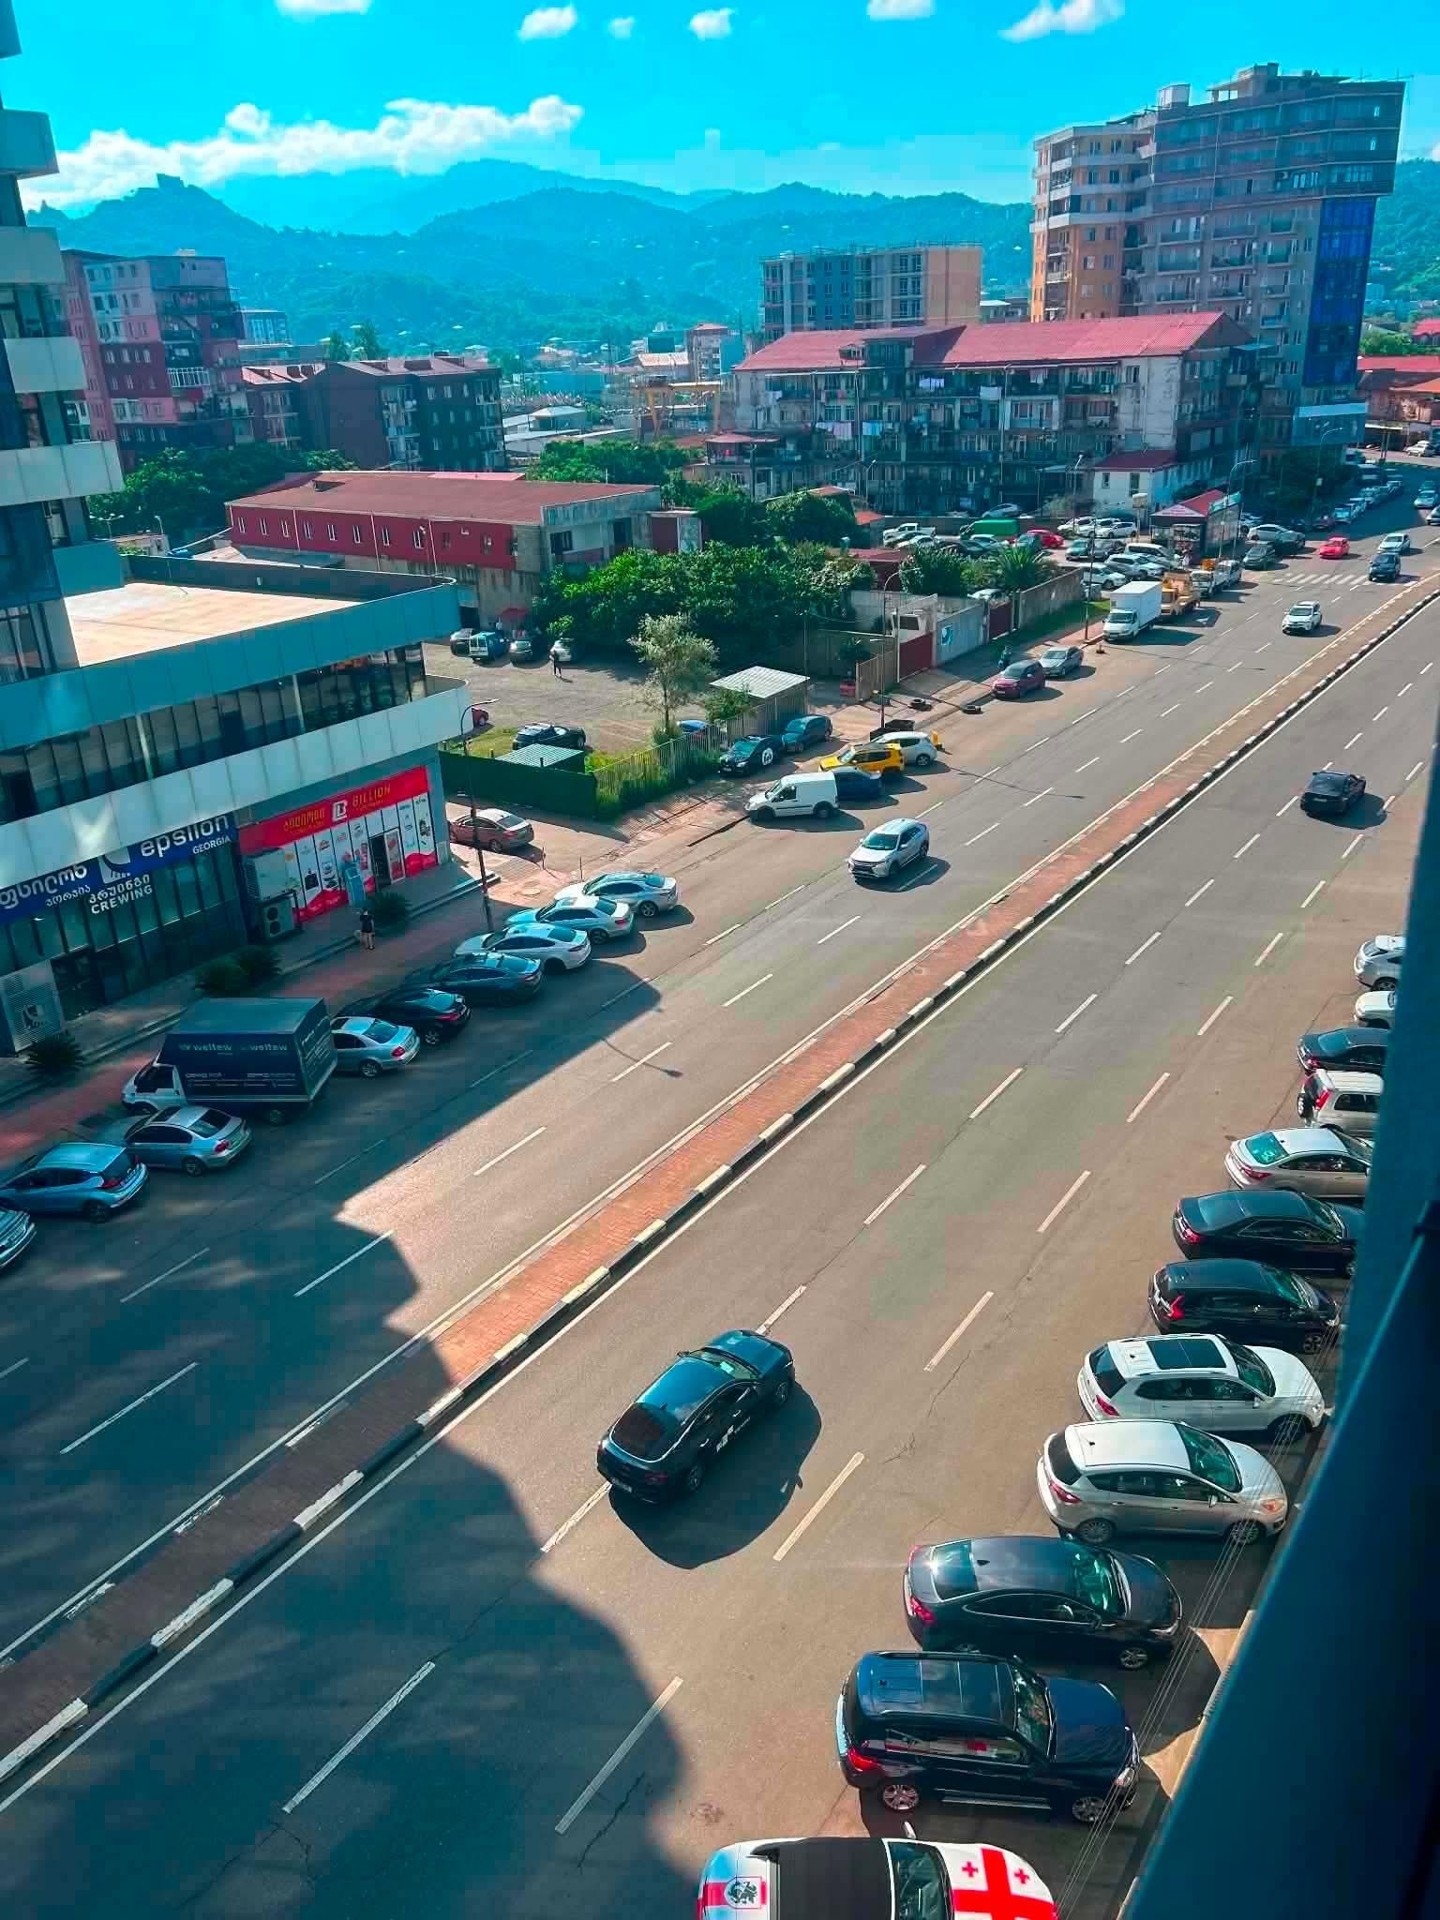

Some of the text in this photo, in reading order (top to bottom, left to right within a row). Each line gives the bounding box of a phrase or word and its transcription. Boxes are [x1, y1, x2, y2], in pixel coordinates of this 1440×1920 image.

[352, 784, 391, 807] BILLION
[140, 815, 229, 858] epsilon
[192, 835, 231, 855] GEORGIA
[91, 885, 153, 914] CREWING
